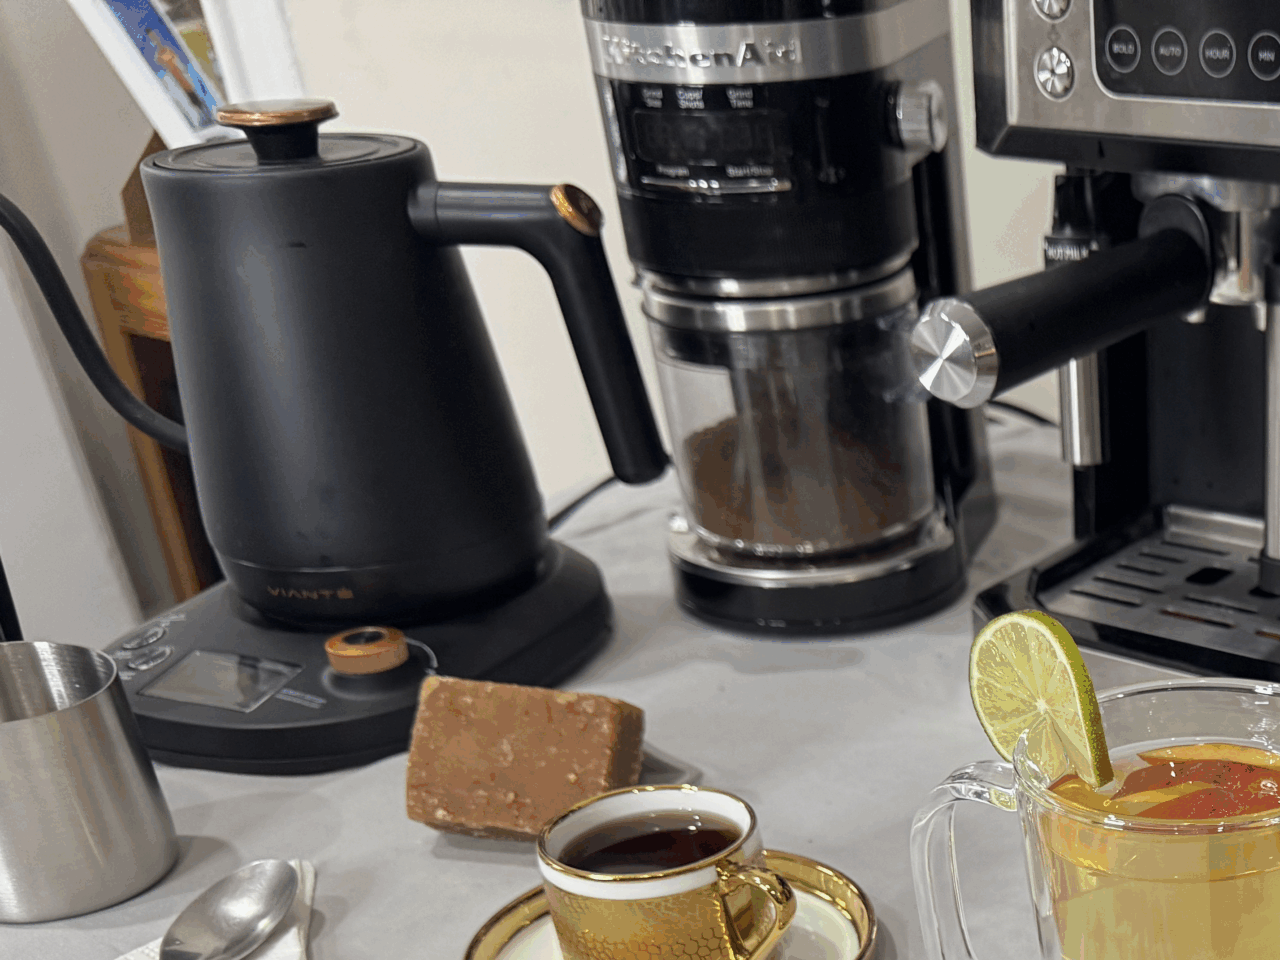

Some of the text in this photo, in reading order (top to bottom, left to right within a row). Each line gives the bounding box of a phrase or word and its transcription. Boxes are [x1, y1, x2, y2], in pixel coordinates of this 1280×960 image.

[1112, 42, 1135, 55] BOLD
[1159, 45, 1182, 57] AUTO
[1205, 47, 1230, 60] HOUR
[1258, 50, 1276, 62] MIN
